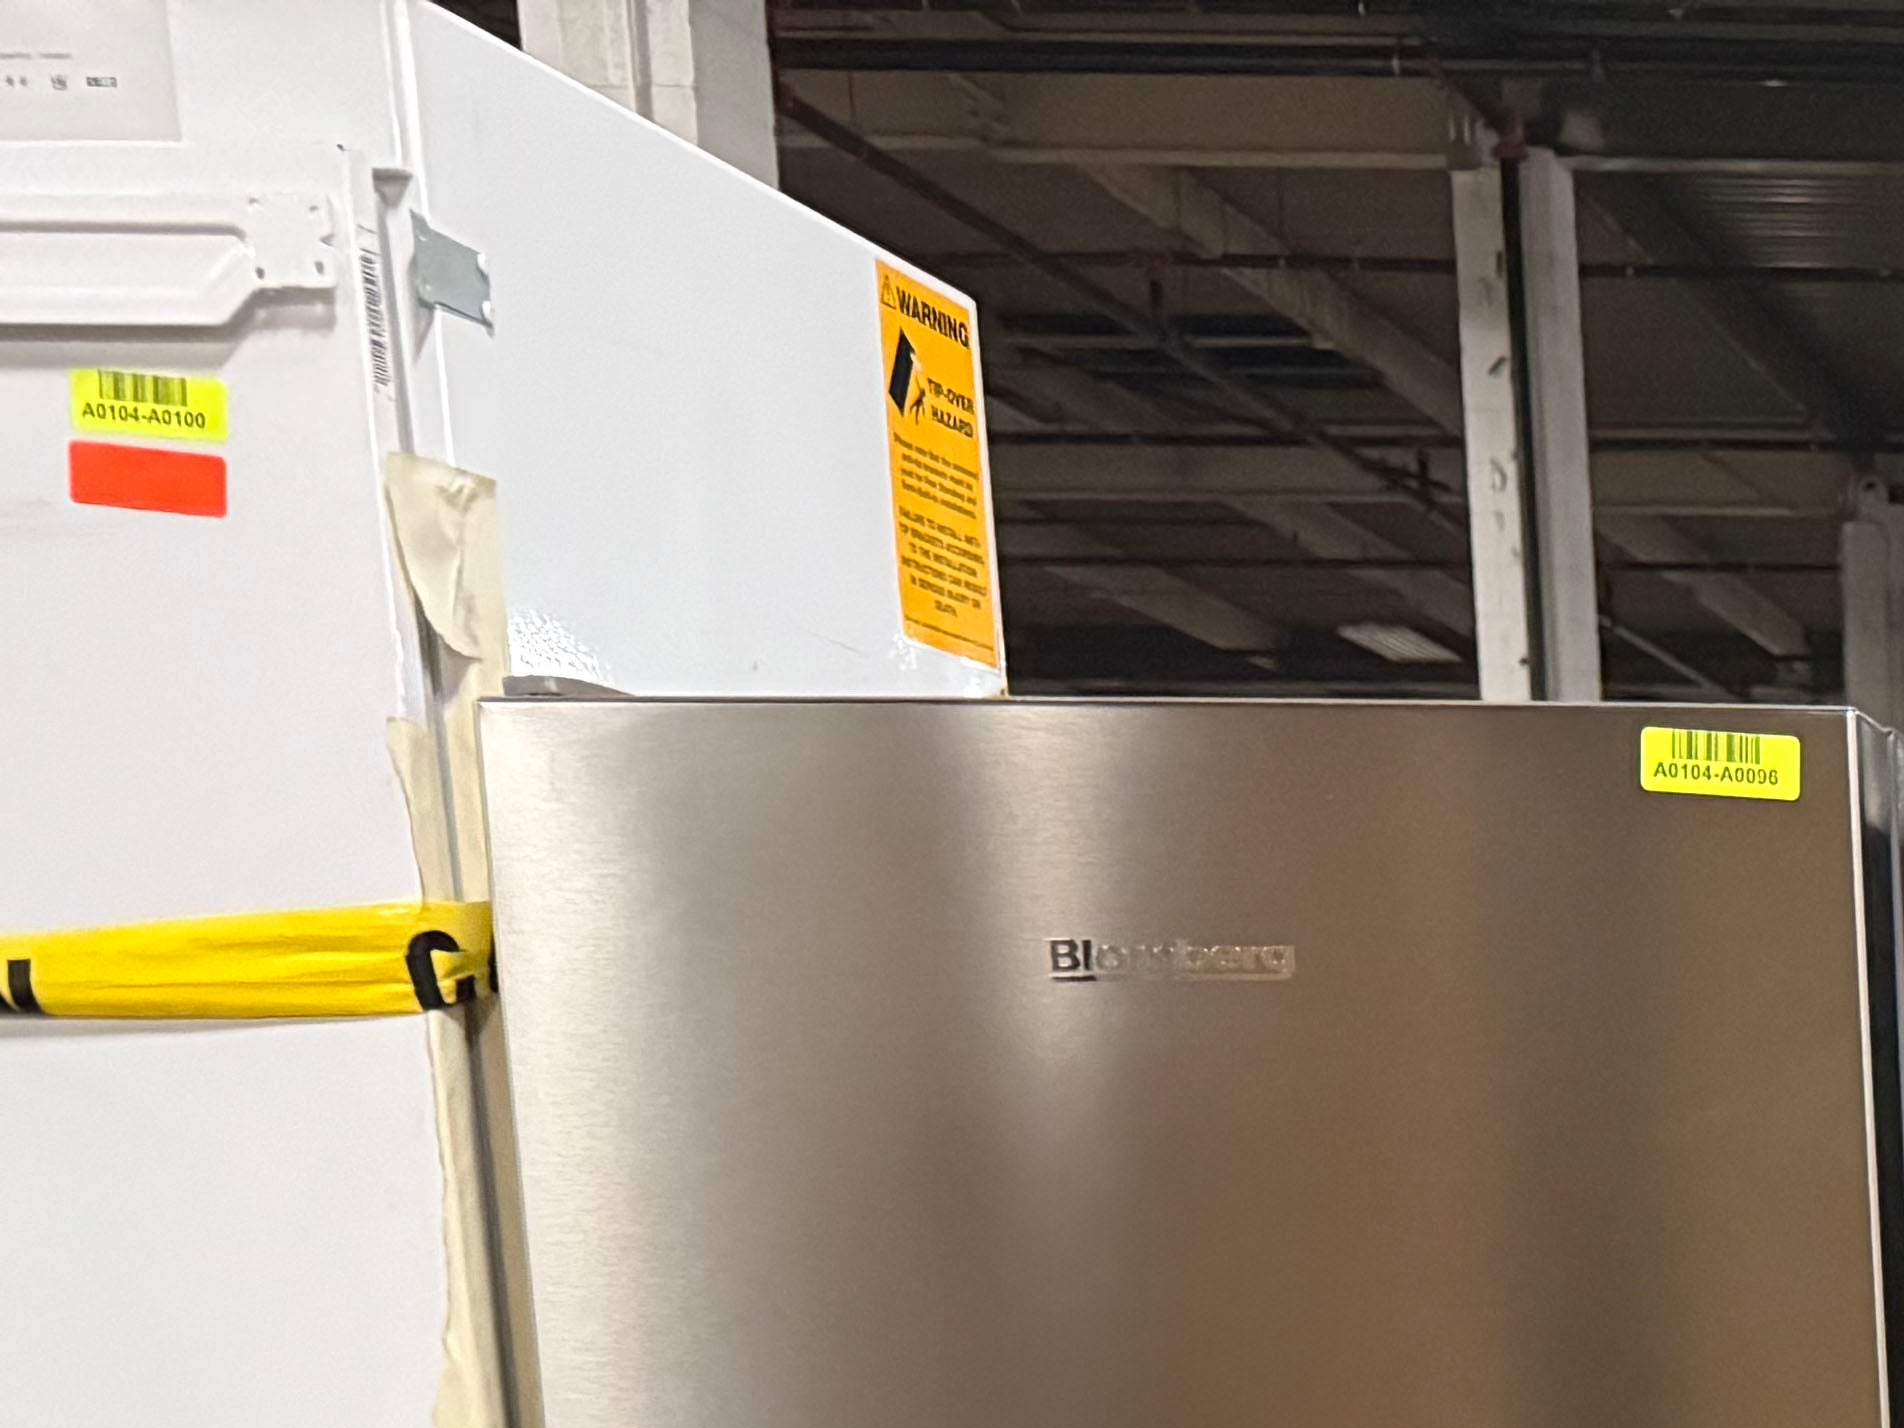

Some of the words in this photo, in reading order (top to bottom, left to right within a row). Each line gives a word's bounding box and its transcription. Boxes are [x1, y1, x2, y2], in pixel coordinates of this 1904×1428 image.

[896, 286, 971, 349] WARNING
[928, 378, 974, 415] TIP-OVER
[82, 402, 206, 429] A0104-A0100
[931, 406, 973, 438] HAZARD
